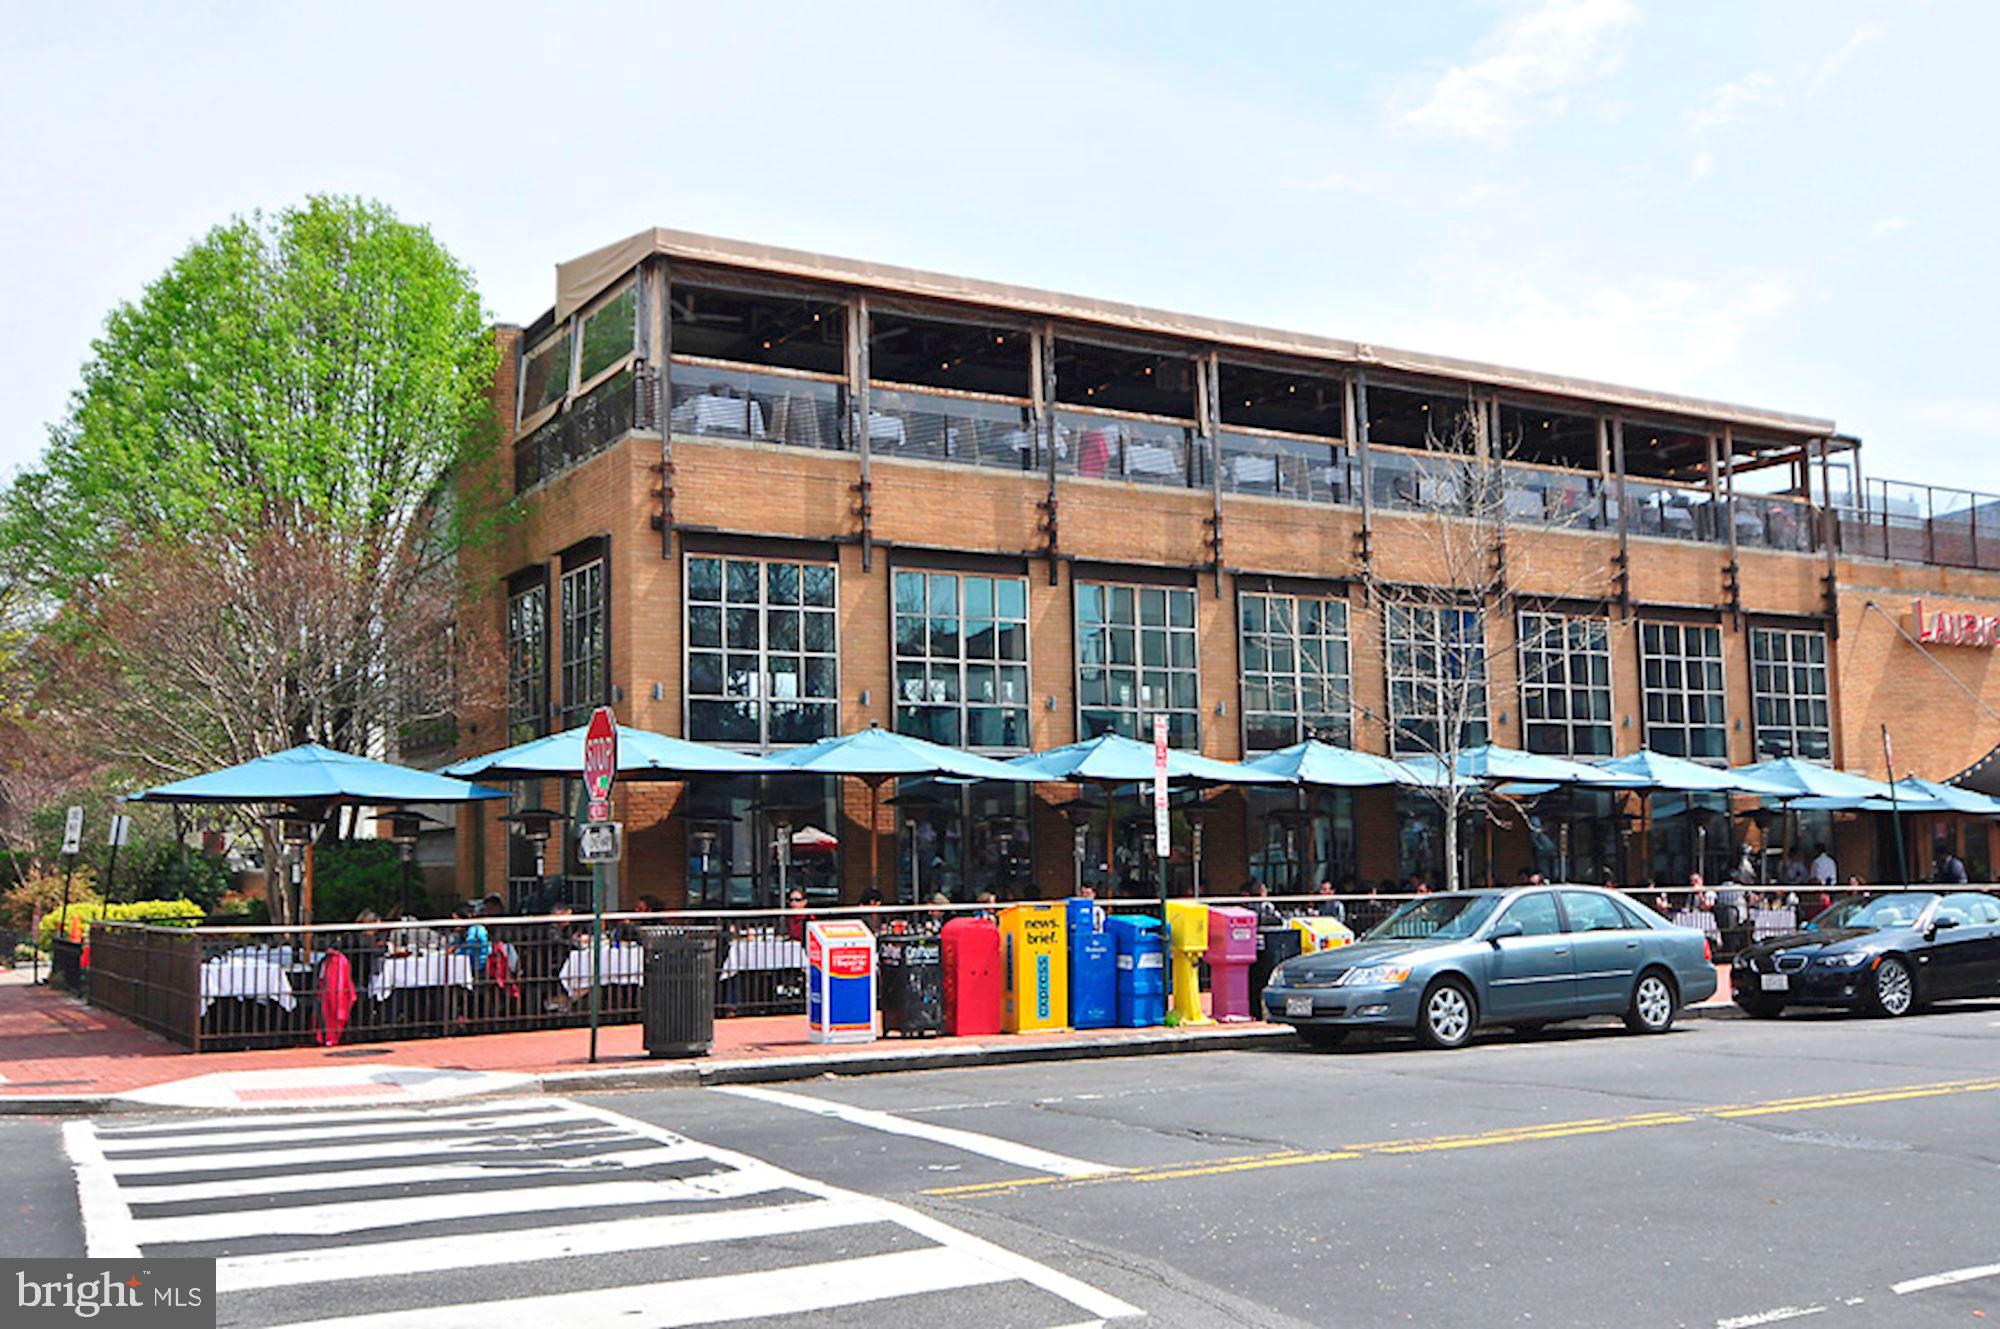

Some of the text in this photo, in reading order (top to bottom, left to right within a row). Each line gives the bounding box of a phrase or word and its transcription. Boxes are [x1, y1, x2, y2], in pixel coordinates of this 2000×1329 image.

[587, 737, 613, 772] STOP
[1024, 918, 1060, 929] news.
[1026, 930, 1058, 945] brief.
[1039, 957, 1050, 1017] express
